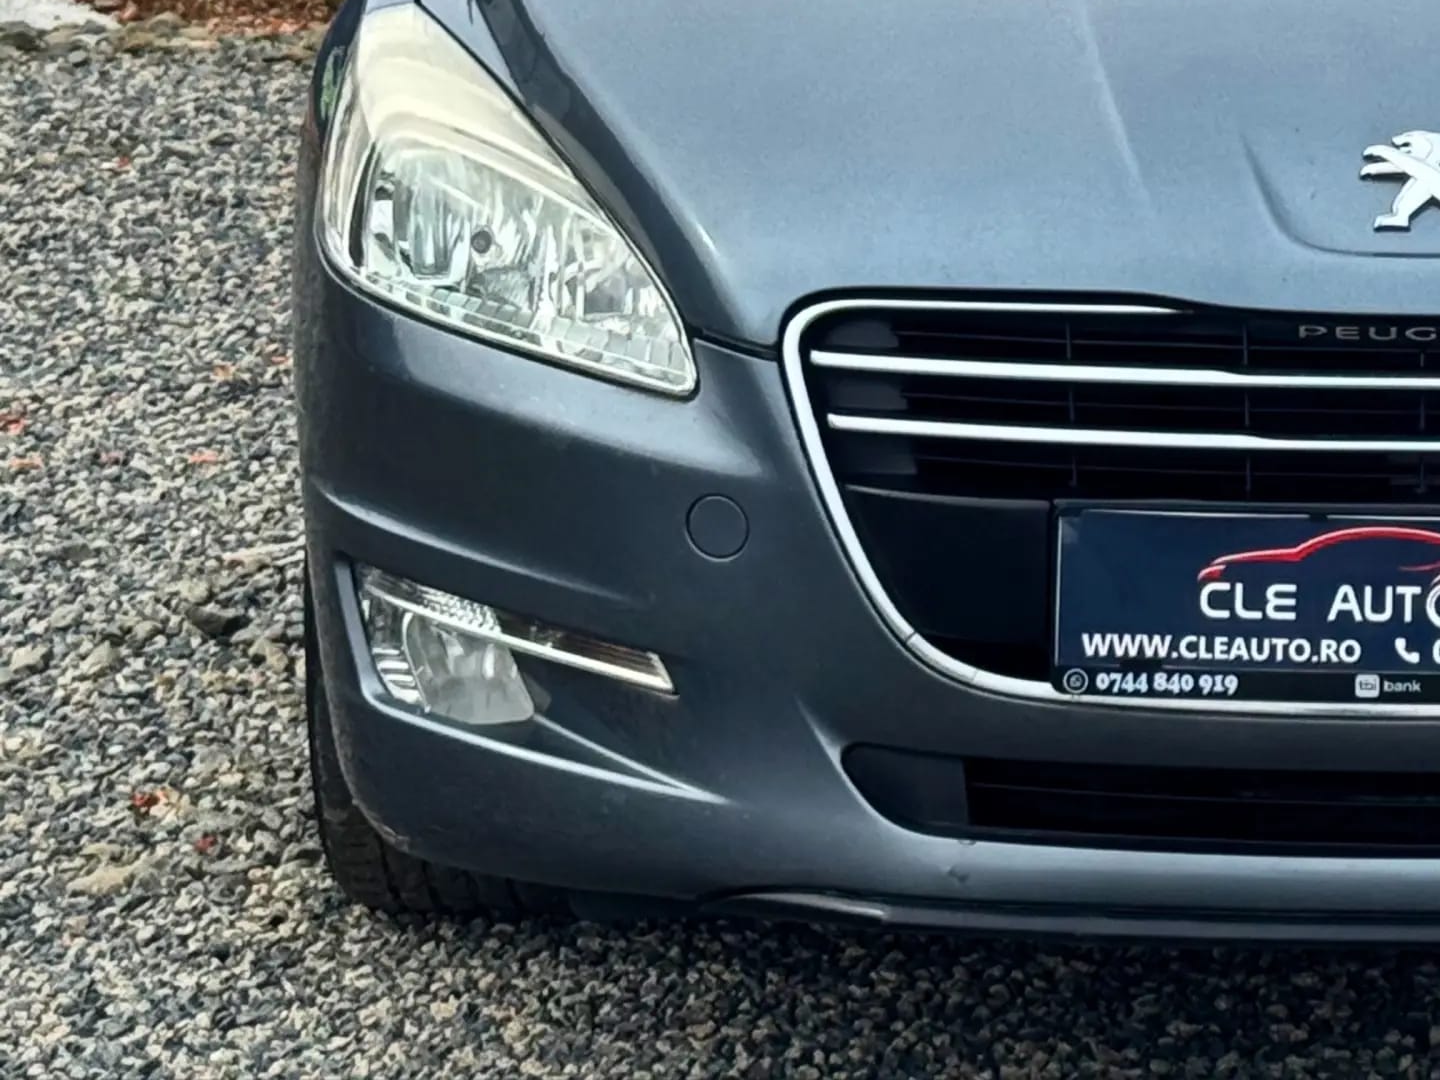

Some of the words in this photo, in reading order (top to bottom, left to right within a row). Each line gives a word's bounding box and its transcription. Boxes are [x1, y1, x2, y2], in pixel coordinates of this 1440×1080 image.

[1200, 582, 1297, 620] CLE
[1081, 632, 1362, 663] WWW.CLEAUTO.RO
[1095, 672, 1149, 693] 0744
[1153, 672, 1194, 694] 840
[1199, 674, 1239, 696] 919
[1383, 680, 1422, 692] bank
